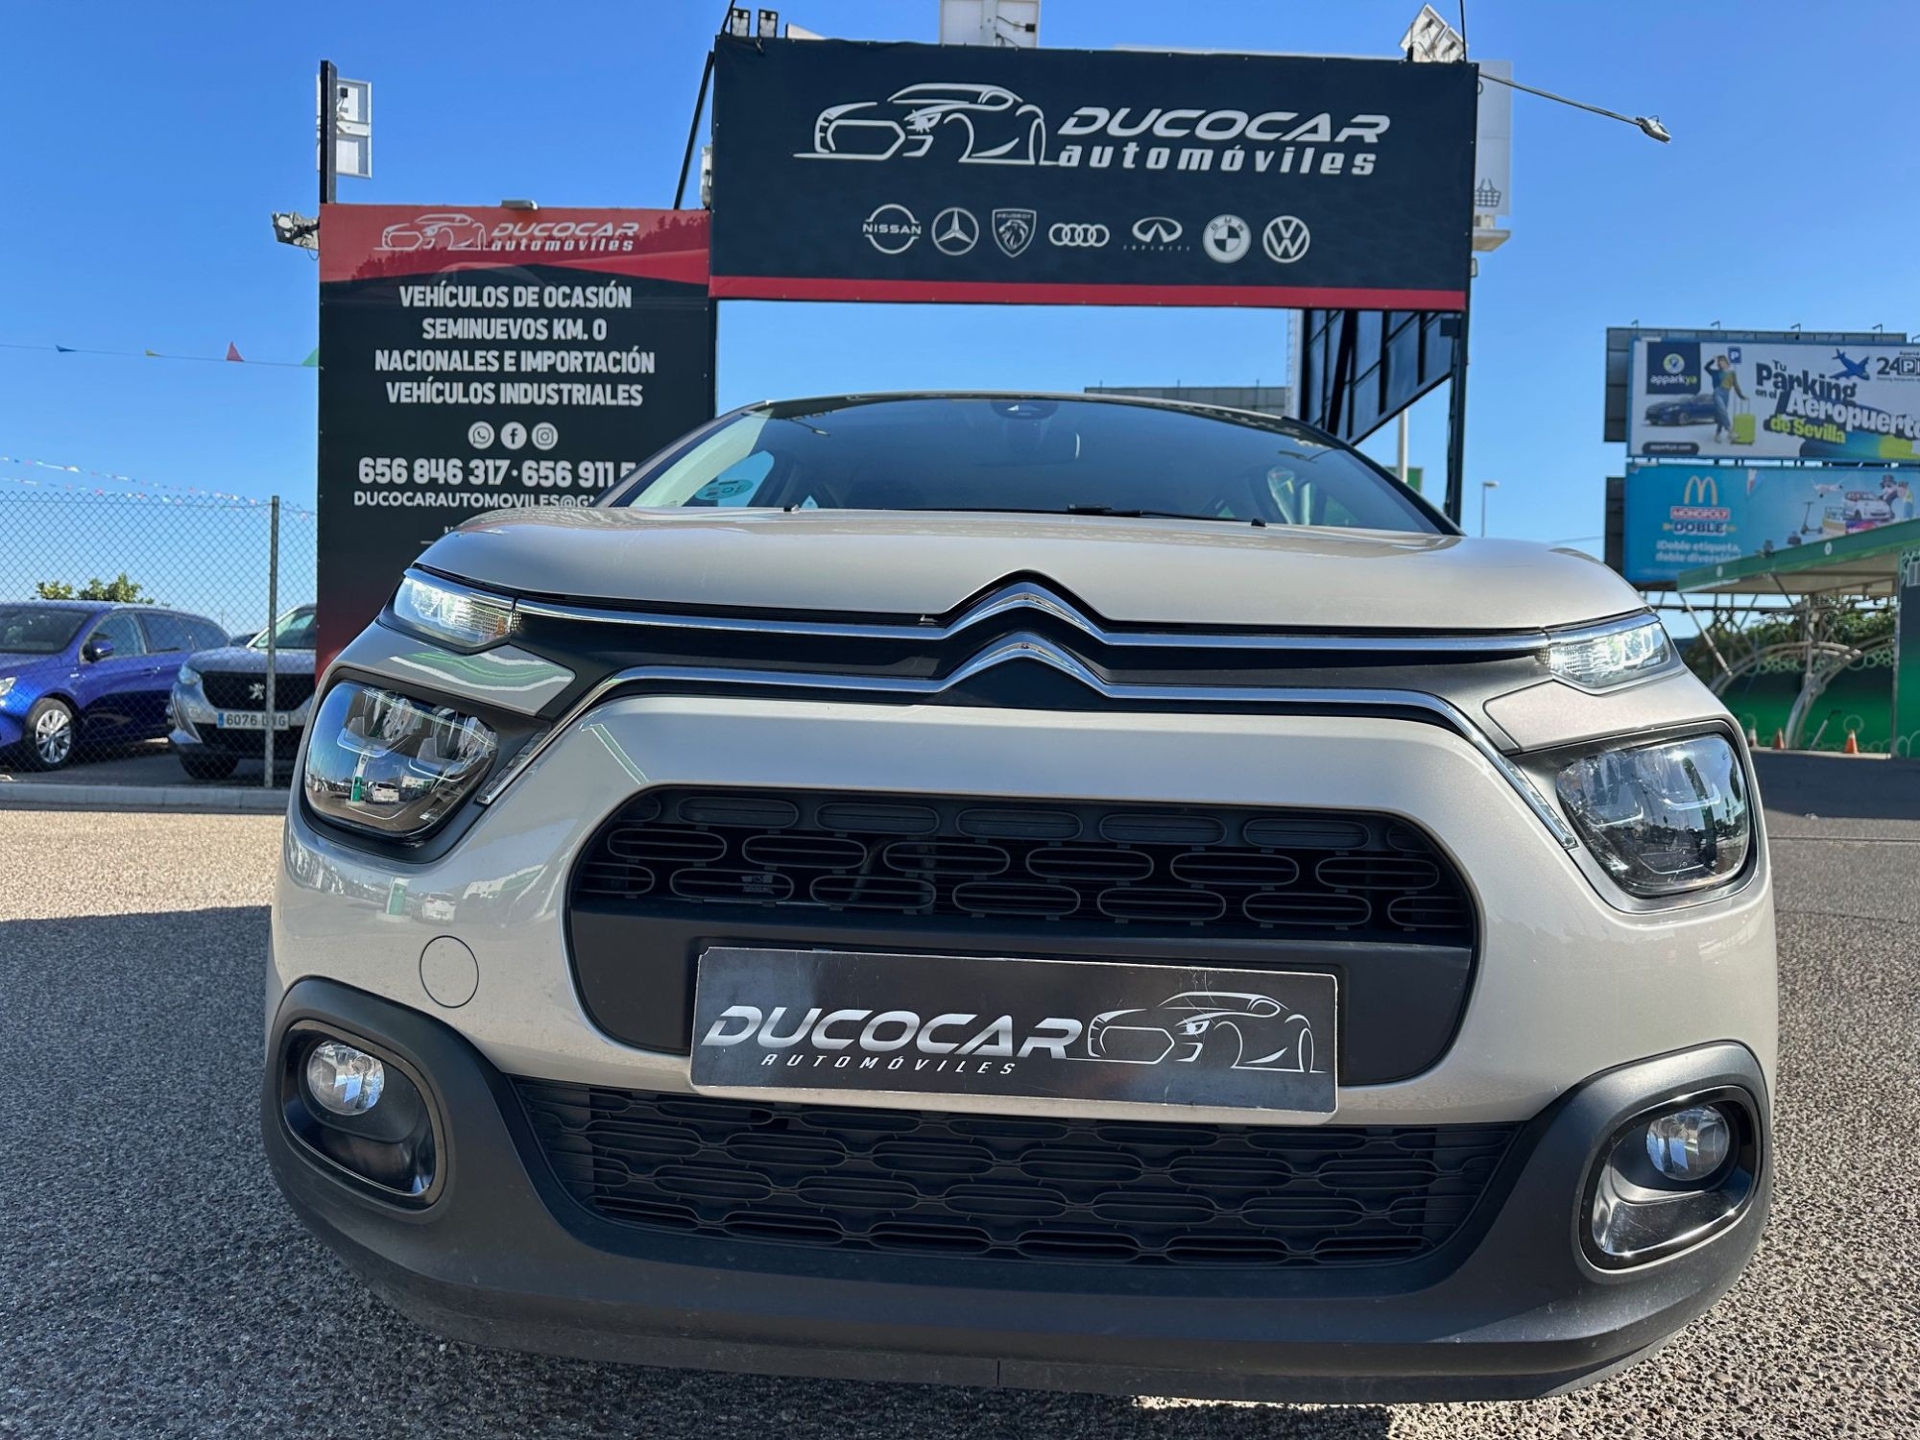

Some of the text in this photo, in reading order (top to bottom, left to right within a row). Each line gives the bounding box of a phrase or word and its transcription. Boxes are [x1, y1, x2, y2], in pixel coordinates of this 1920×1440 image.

[1057, 106, 1391, 143] DUCOCAR
[1058, 142, 1377, 175] automóviles
[491, 222, 640, 237] DUCOCAR
[862, 223, 922, 234] NISSAN
[399, 280, 632, 308] VEHÍCULOS DE OCASIÓN
[422, 318, 549, 340] SEMINUEVOS
[552, 318, 589, 340] KM.
[375, 345, 655, 373] NACIONALES E IMPORTACIÓN
[1772, 359, 1787, 372] Tu
[1650, 374, 1698, 385] apparkya
[1756, 362, 1857, 400] Parking
[386, 376, 643, 406] VEHÍCULOS INDUSTRIALES
[1755, 388, 1778, 399] en el
[1770, 414, 1846, 444] de Sevilla
[359, 457, 408, 484] 656
[413, 457, 464, 485] 846
[578, 460, 615, 488] 911
[353, 491, 595, 508] DUCOCARAUTOMOVILES@G
[1674, 521, 1725, 534] DOBLE
[226, 713, 258, 726] 6076
[701, 1005, 1084, 1059] DUCOCAR
[761, 1053, 1016, 1075] AUTOMÓVILES
